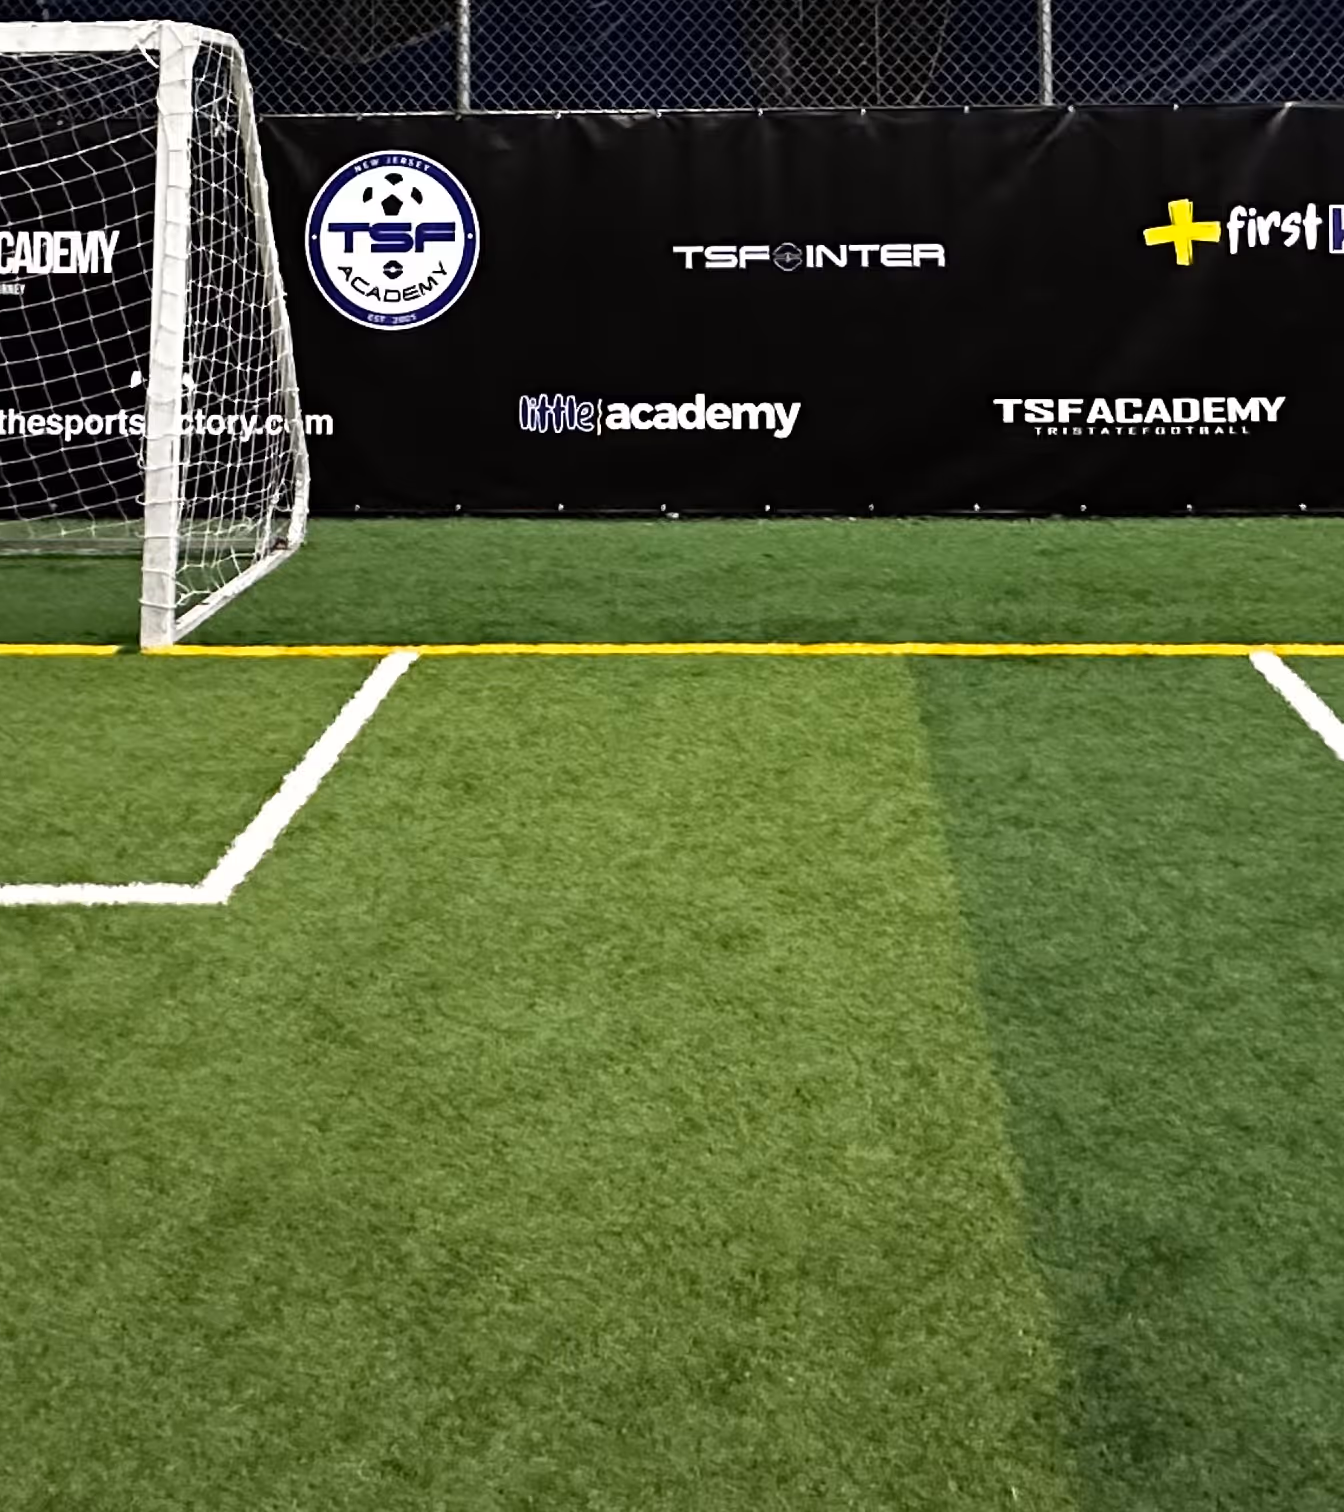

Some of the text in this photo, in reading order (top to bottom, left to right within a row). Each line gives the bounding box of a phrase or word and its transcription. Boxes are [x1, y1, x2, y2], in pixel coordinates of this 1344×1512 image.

[327, 222, 456, 254] TSF
[672, 243, 946, 269] TSF INTER
[337, 260, 447, 303] ACADEMY
[518, 393, 802, 439] little academy
